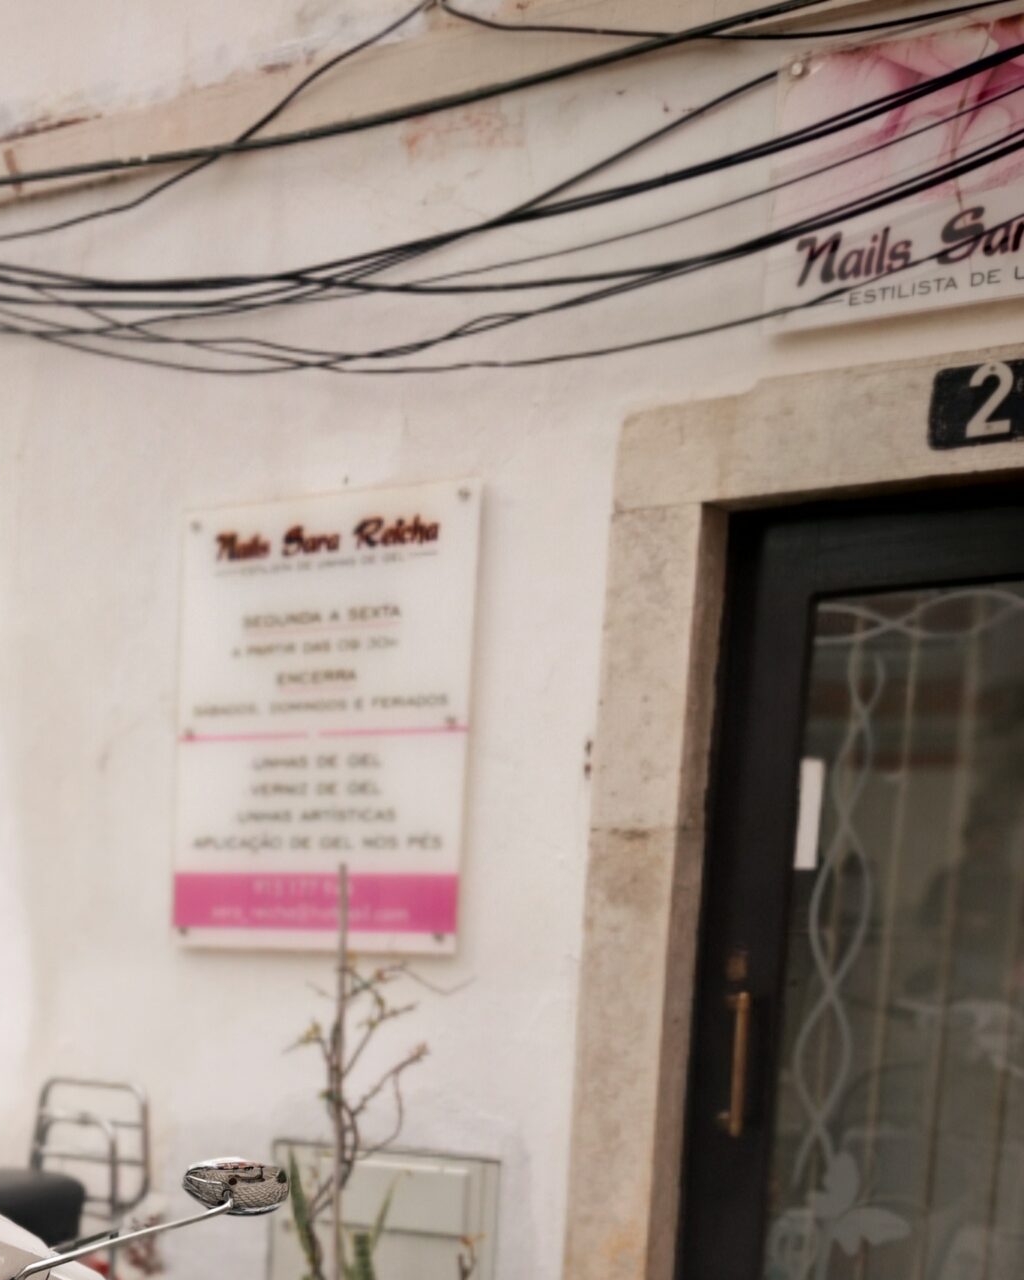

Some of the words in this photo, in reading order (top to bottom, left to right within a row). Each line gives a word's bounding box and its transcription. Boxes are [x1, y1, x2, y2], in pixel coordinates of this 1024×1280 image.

[796, 226, 913, 288] Nails
[848, 276, 959, 307] ESTILISTA
[970, 269, 1002, 288] DE
[348, 605, 401, 621] SEXTA
[277, 668, 357, 686] ENCERRA
[317, 754, 337, 769] DE
[347, 752, 381, 769] GEL
[317, 781, 337, 796] DE
[347, 779, 381, 796] GEL
[290, 835, 311, 849] DE
[319, 836, 354, 850] GEL
[407, 830, 443, 849] PÉS
